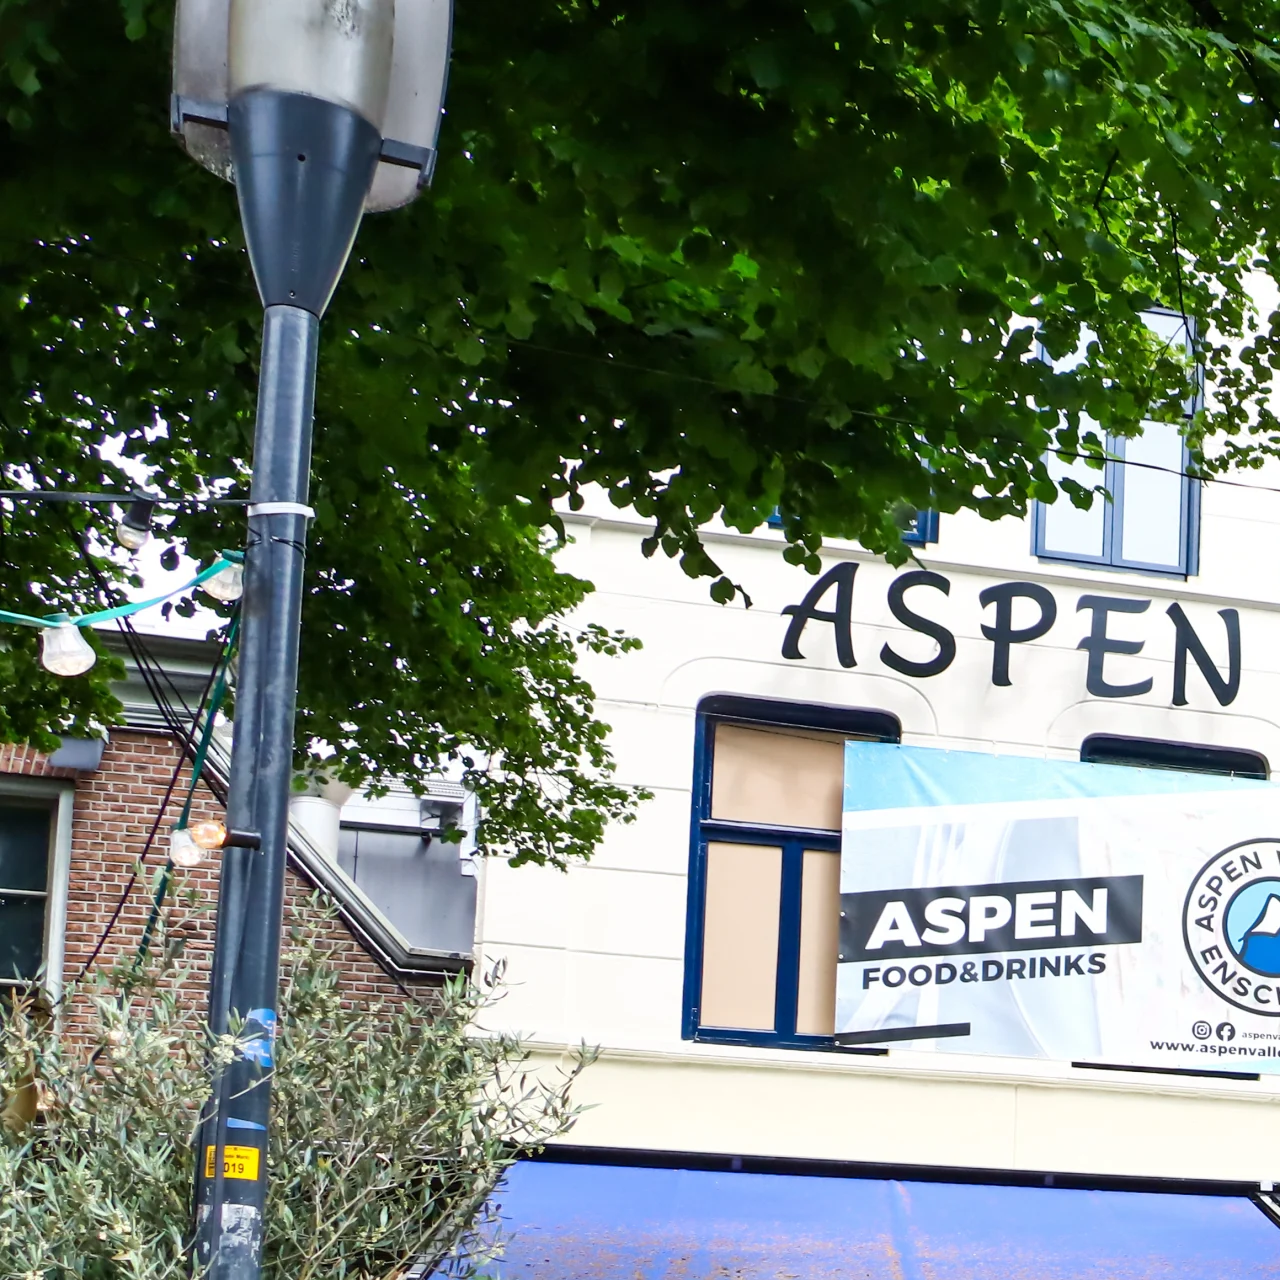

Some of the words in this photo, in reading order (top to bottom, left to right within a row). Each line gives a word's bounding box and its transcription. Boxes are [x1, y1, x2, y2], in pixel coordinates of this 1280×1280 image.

[780, 562, 1242, 707] ASPEN
[864, 887, 1108, 950] ASPEN
[1195, 851, 1263, 932] ASPEN
[862, 952, 1107, 990] FOOD&DRINKS
